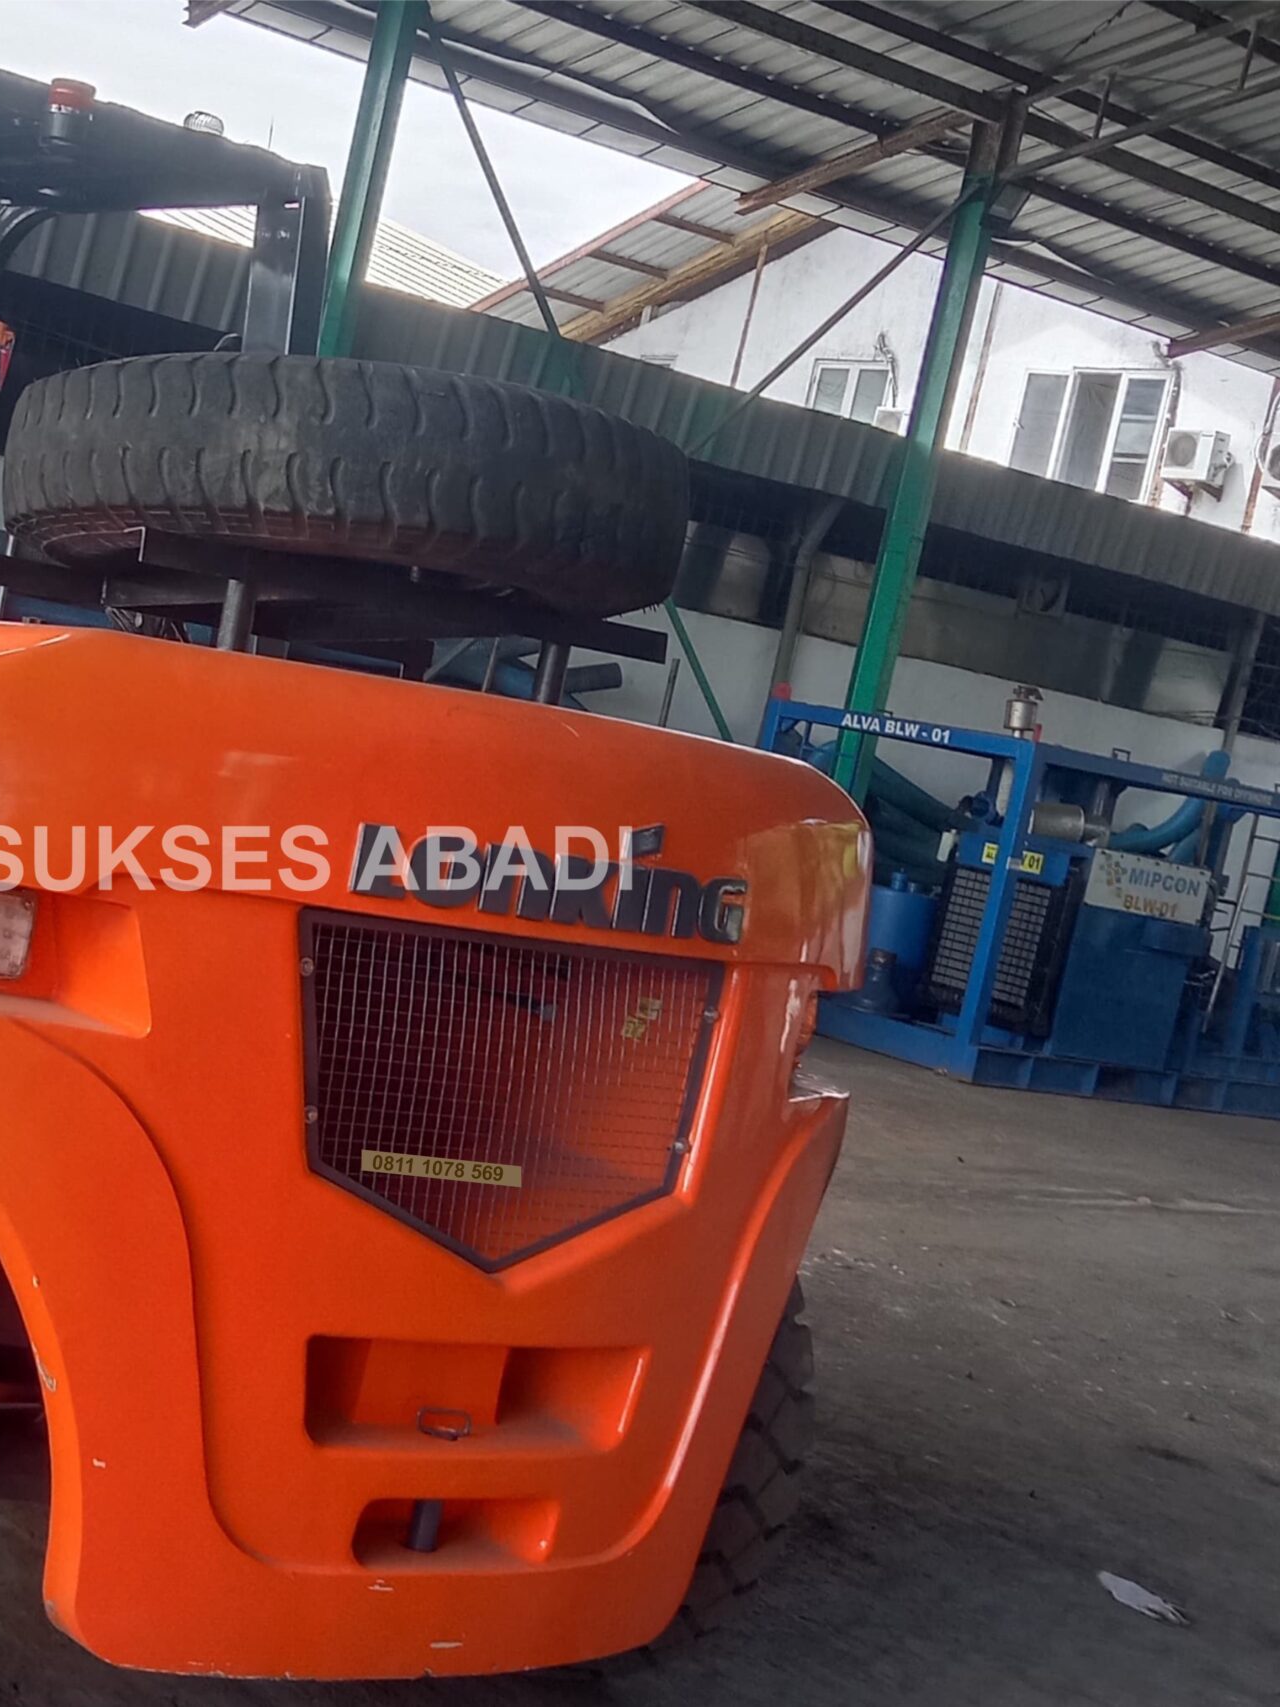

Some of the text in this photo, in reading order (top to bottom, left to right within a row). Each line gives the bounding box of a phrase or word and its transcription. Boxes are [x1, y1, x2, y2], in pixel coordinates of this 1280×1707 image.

[841, 713, 880, 732] ALVA
[884, 720, 919, 738] BLW
[931, 728, 951, 744] 01
[1028, 855, 1040, 870] 01
[1128, 867, 1200, 897] MIPCON
[1123, 894, 1178, 917] BLW-01
[372, 1154, 504, 1181] 0811 1078 569
